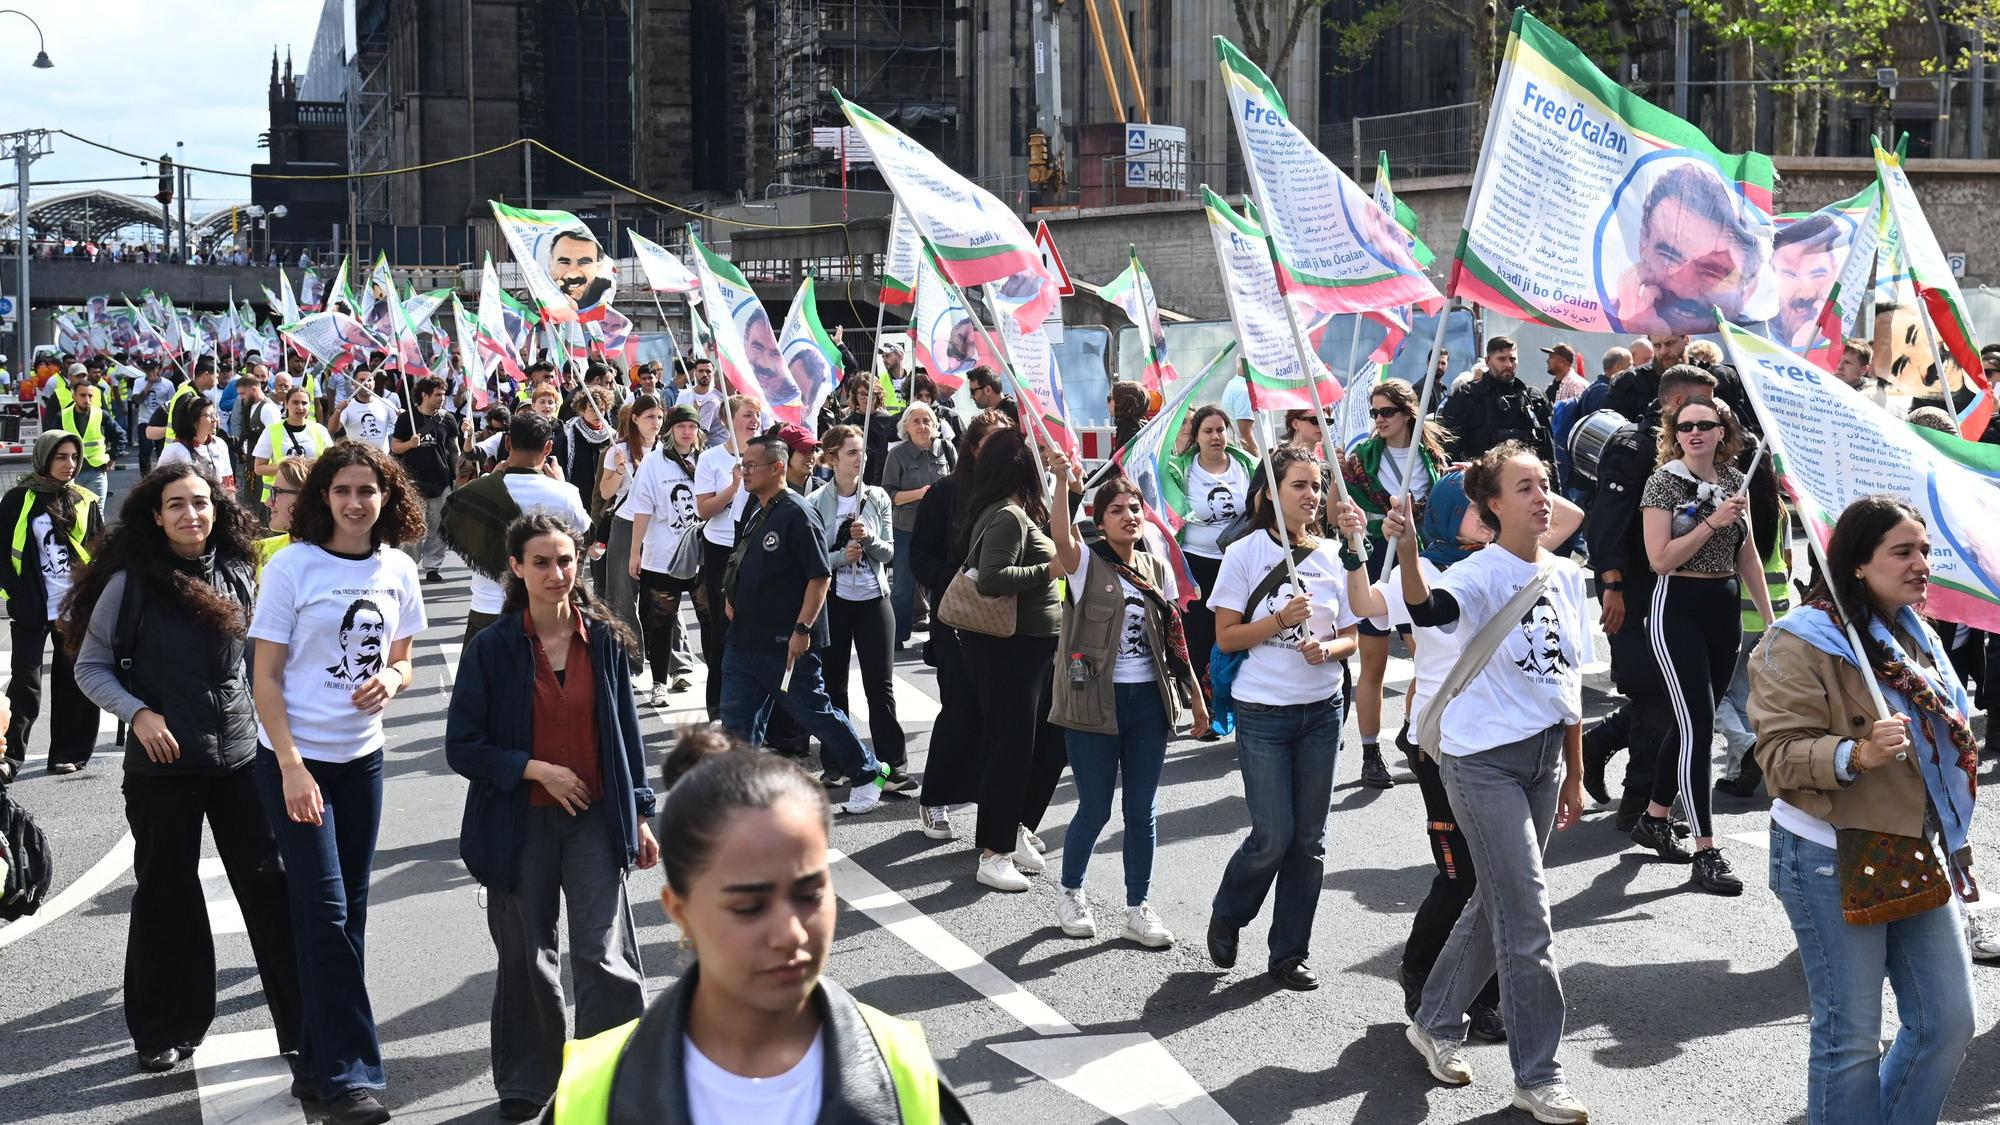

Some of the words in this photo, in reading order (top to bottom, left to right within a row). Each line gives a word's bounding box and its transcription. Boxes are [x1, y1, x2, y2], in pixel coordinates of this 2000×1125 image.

[1523, 81, 1566, 125] Free
[1568, 103, 1627, 154] Öcalan
[1312, 257, 1320, 271] ji
[1319, 257, 1332, 268] bo
[1333, 249, 1365, 265] Öcalan
[1952, 259, 1962, 276] P
[1496, 265, 1522, 287] Azadî
[1522, 276, 1532, 292] ji
[1533, 282, 1549, 299] bo
[1552, 287, 1598, 311] Öcalan
[1855, 478, 1875, 488] Frihet
[1887, 482, 1911, 492] Öcalan
[1929, 544, 1952, 557] lan
